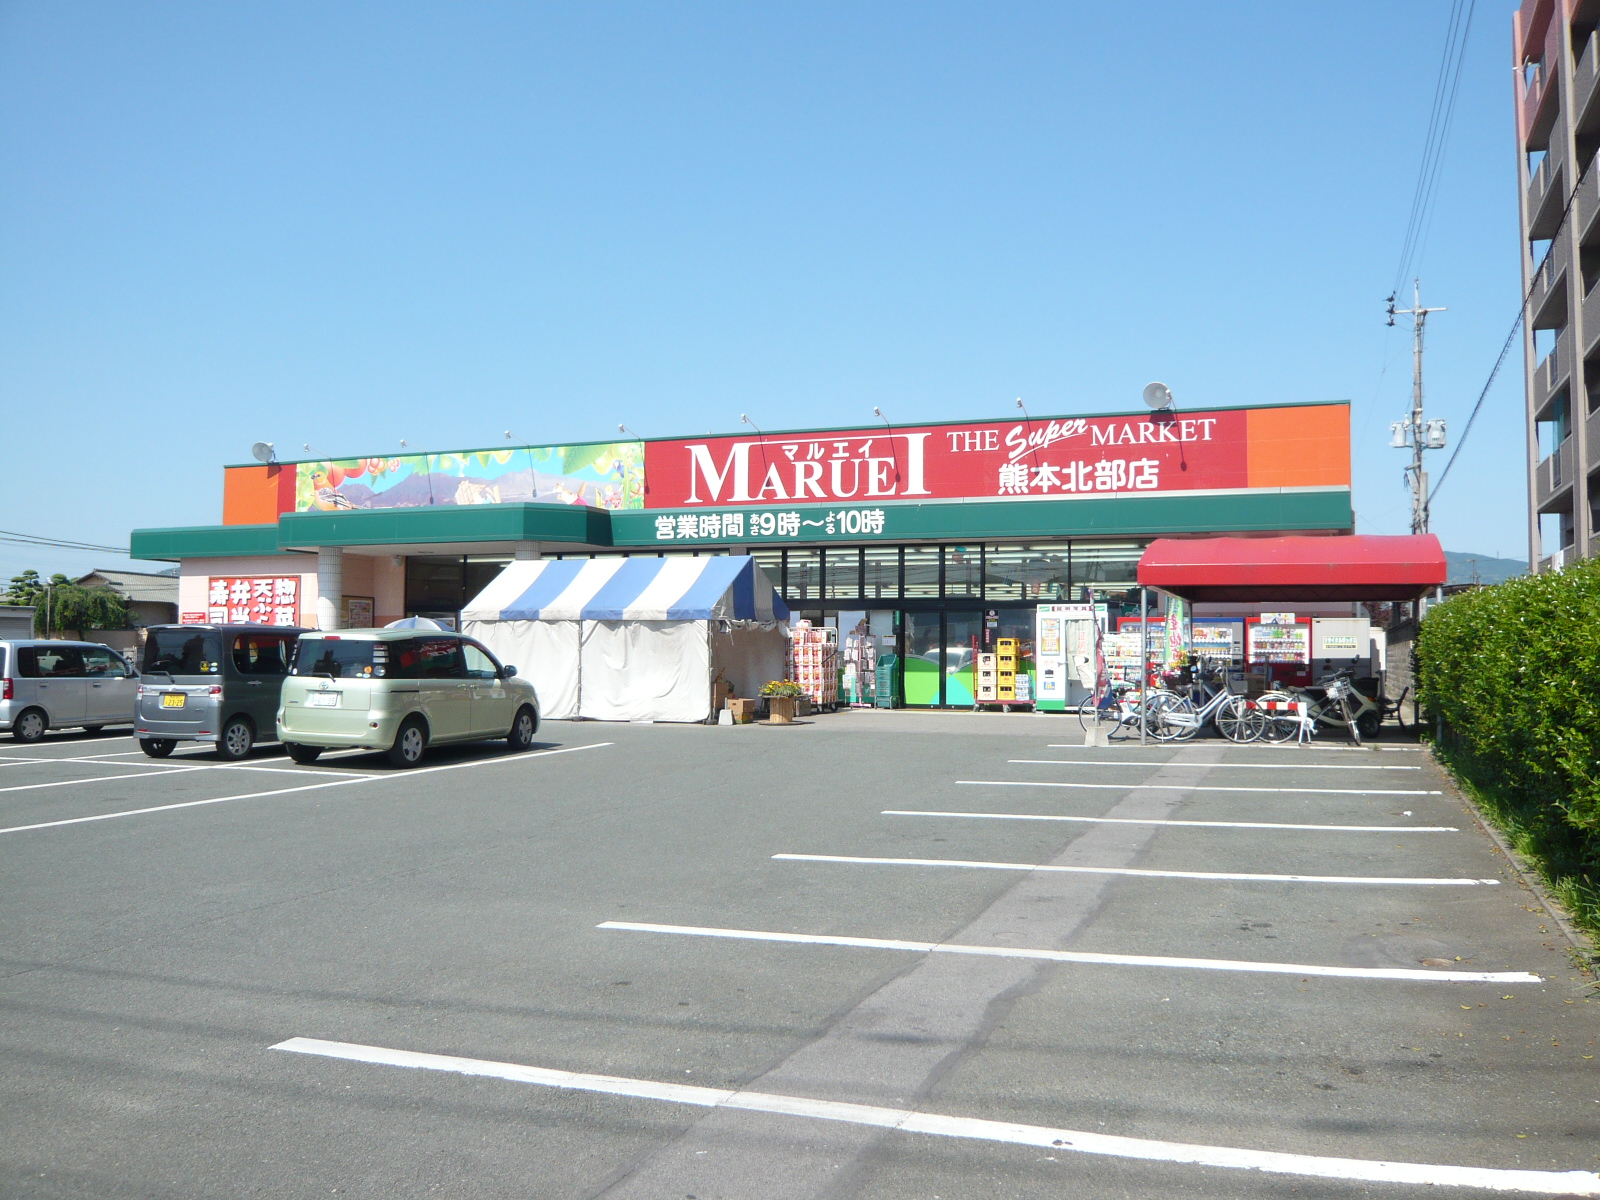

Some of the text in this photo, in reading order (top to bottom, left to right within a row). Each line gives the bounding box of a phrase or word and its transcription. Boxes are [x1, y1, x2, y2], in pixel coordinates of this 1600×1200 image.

[782, 439, 873, 461] マルエイ
[947, 418, 1216, 464] THE Super MARKET
[684, 433, 931, 503] MARUEI
[998, 458, 1159, 495] 熊本北部店
[655, 513, 743, 539] 営業時間
